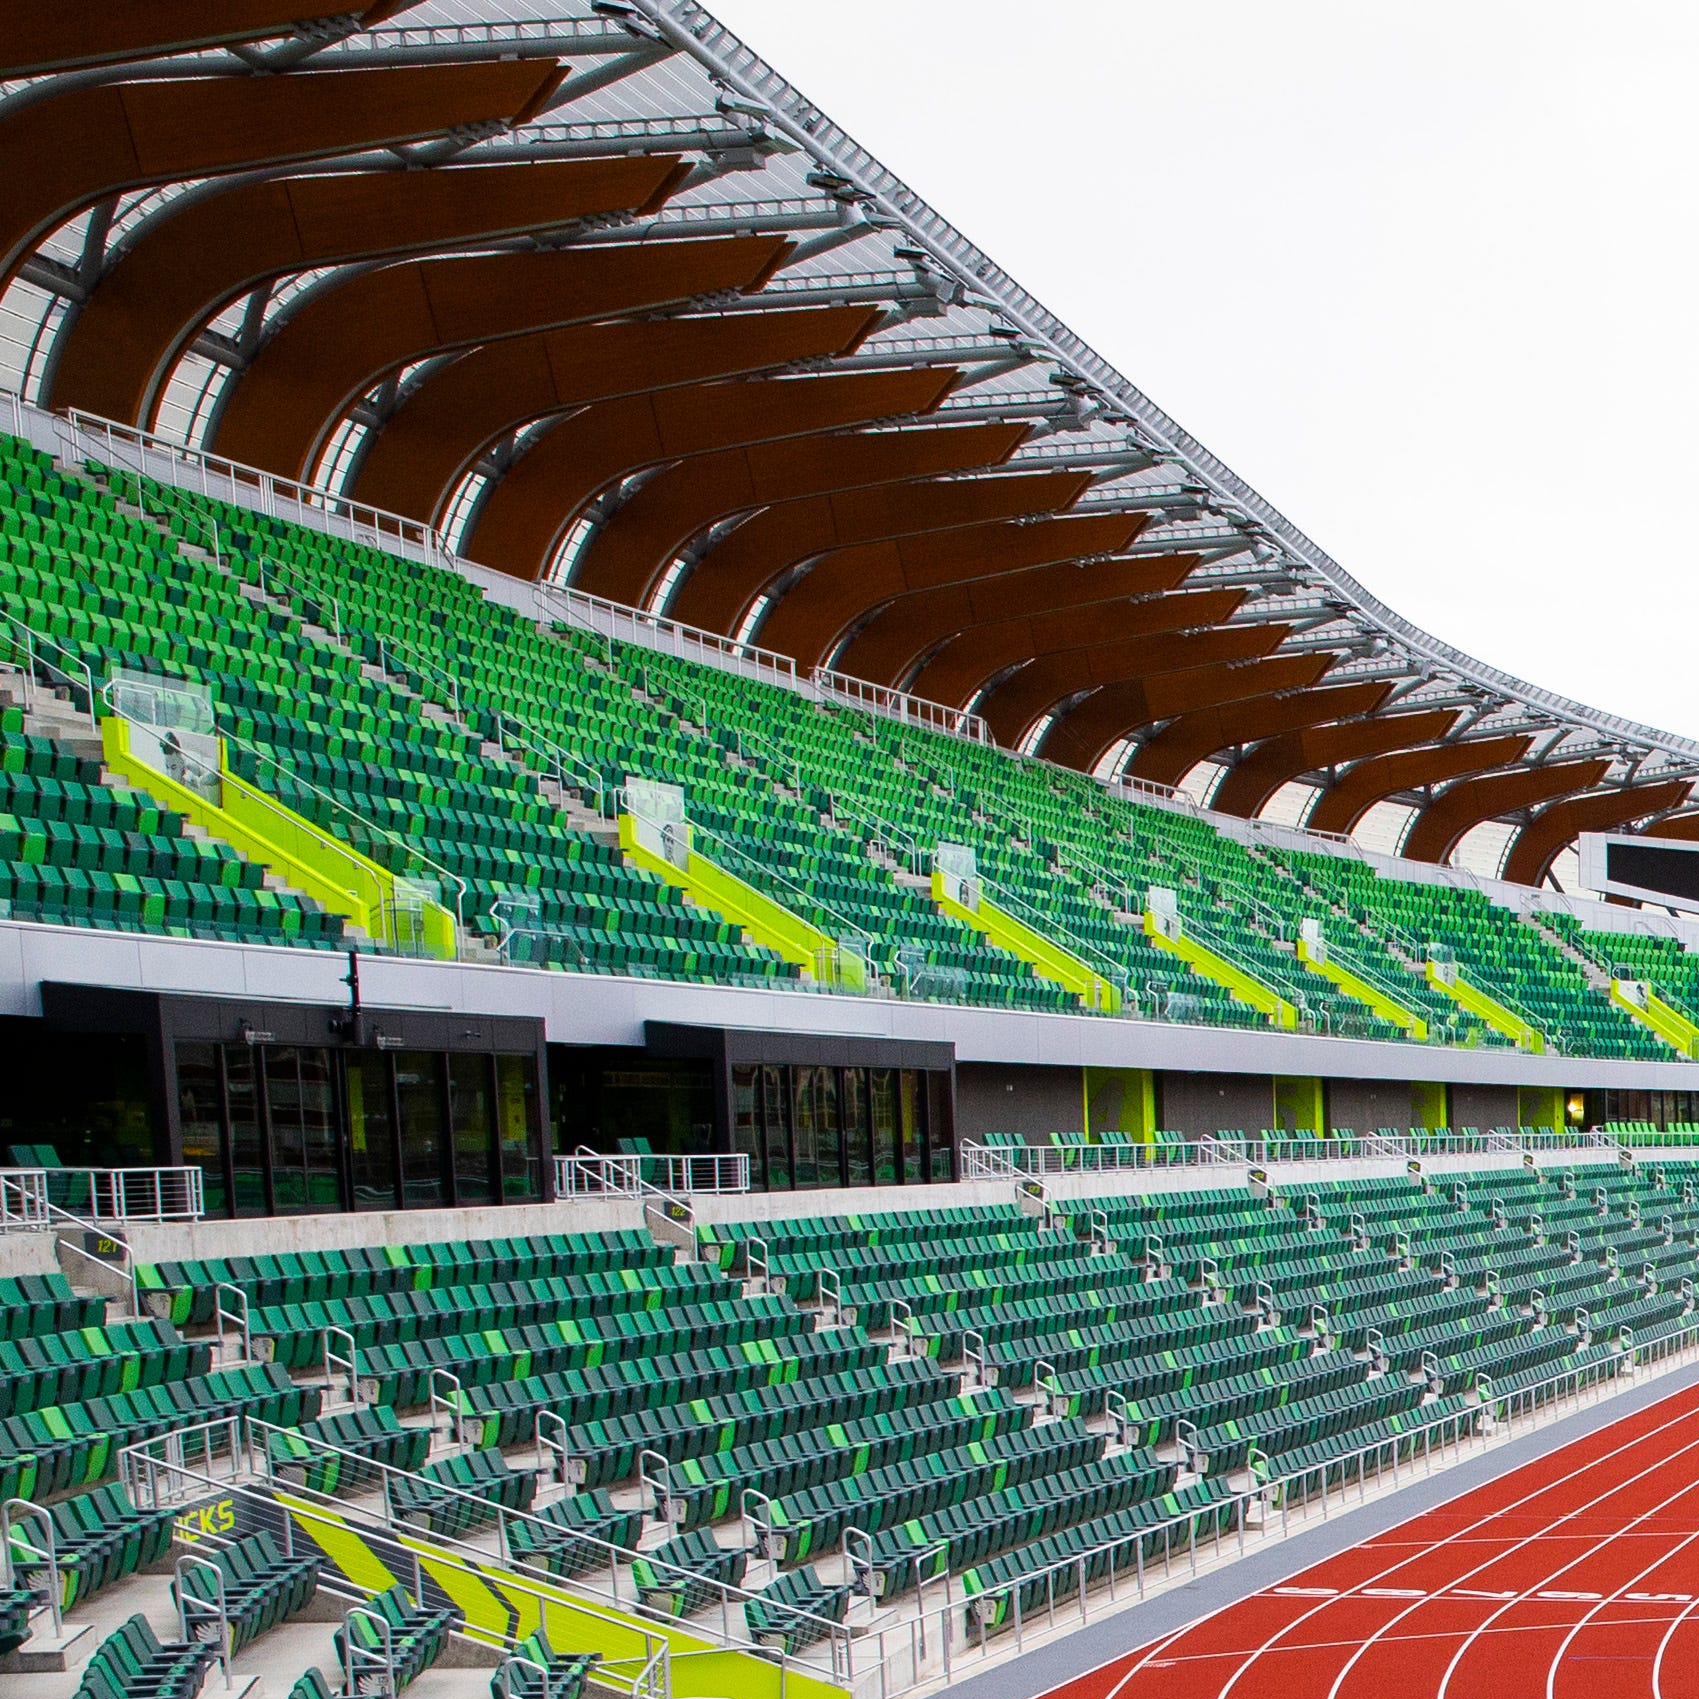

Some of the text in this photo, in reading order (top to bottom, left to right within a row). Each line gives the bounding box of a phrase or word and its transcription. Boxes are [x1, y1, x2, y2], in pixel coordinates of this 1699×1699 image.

[96, 1239, 119, 1254] 121
[177, 1499, 235, 1542] CKS
[1451, 1589, 1518, 1598] 7
